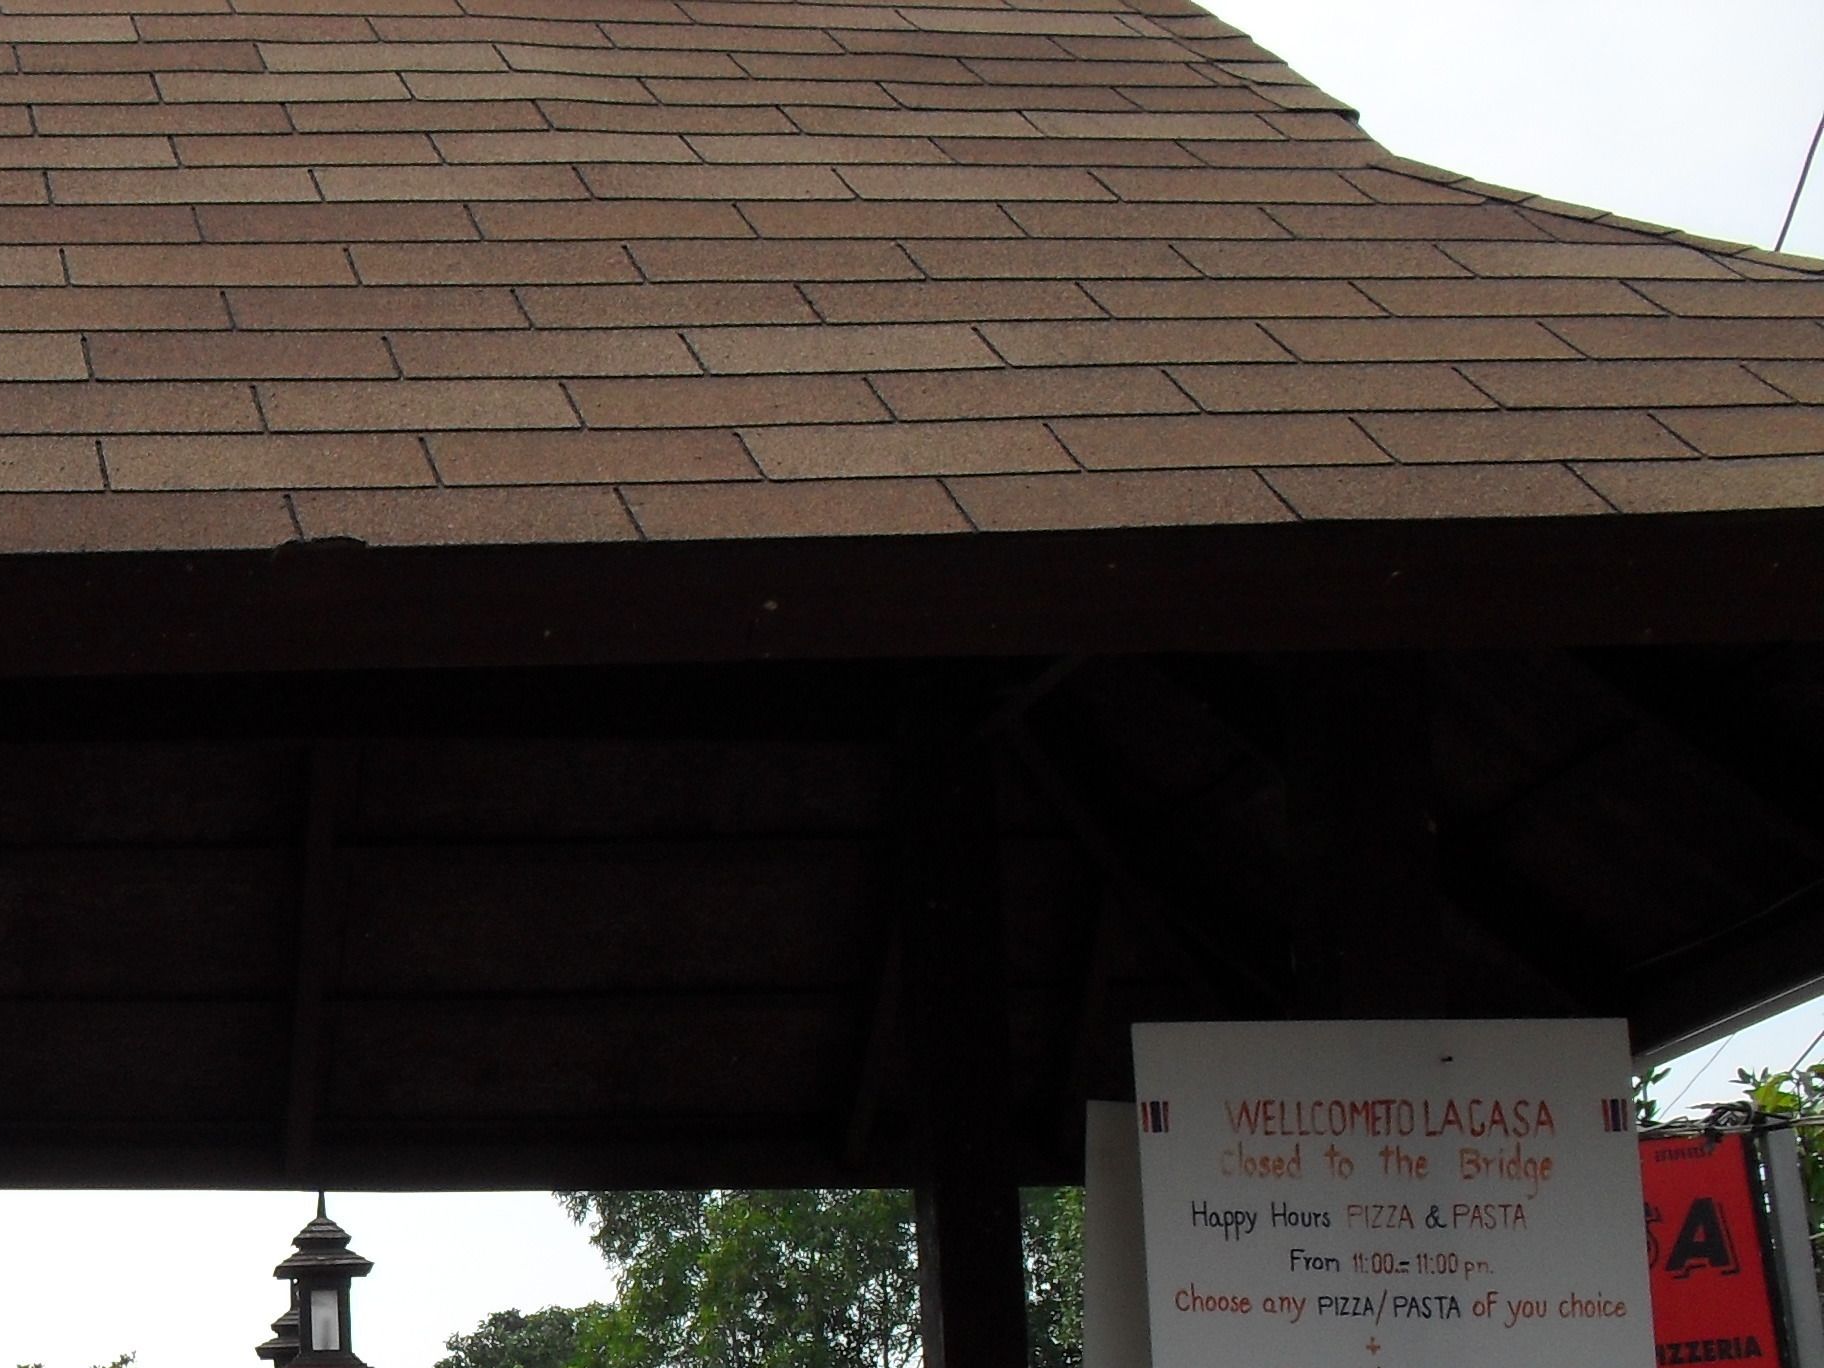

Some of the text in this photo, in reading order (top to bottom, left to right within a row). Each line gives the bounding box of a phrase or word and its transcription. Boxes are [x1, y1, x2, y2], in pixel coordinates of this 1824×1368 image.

[1325, 1144, 1354, 1179] to
[1379, 1144, 1428, 1179] the
[1459, 1142, 1554, 1200] Bridge
[1191, 1202, 1527, 1241] Happy Hours PIZZA & PASTA
[1290, 1249, 1340, 1273] From
[1262, 1296, 1307, 1325] any
[1471, 1291, 1499, 1317] of
[1506, 1300, 1547, 1328] you
[1558, 1292, 1628, 1318] choice
[1656, 1336, 1762, 1366] IZZERIA
